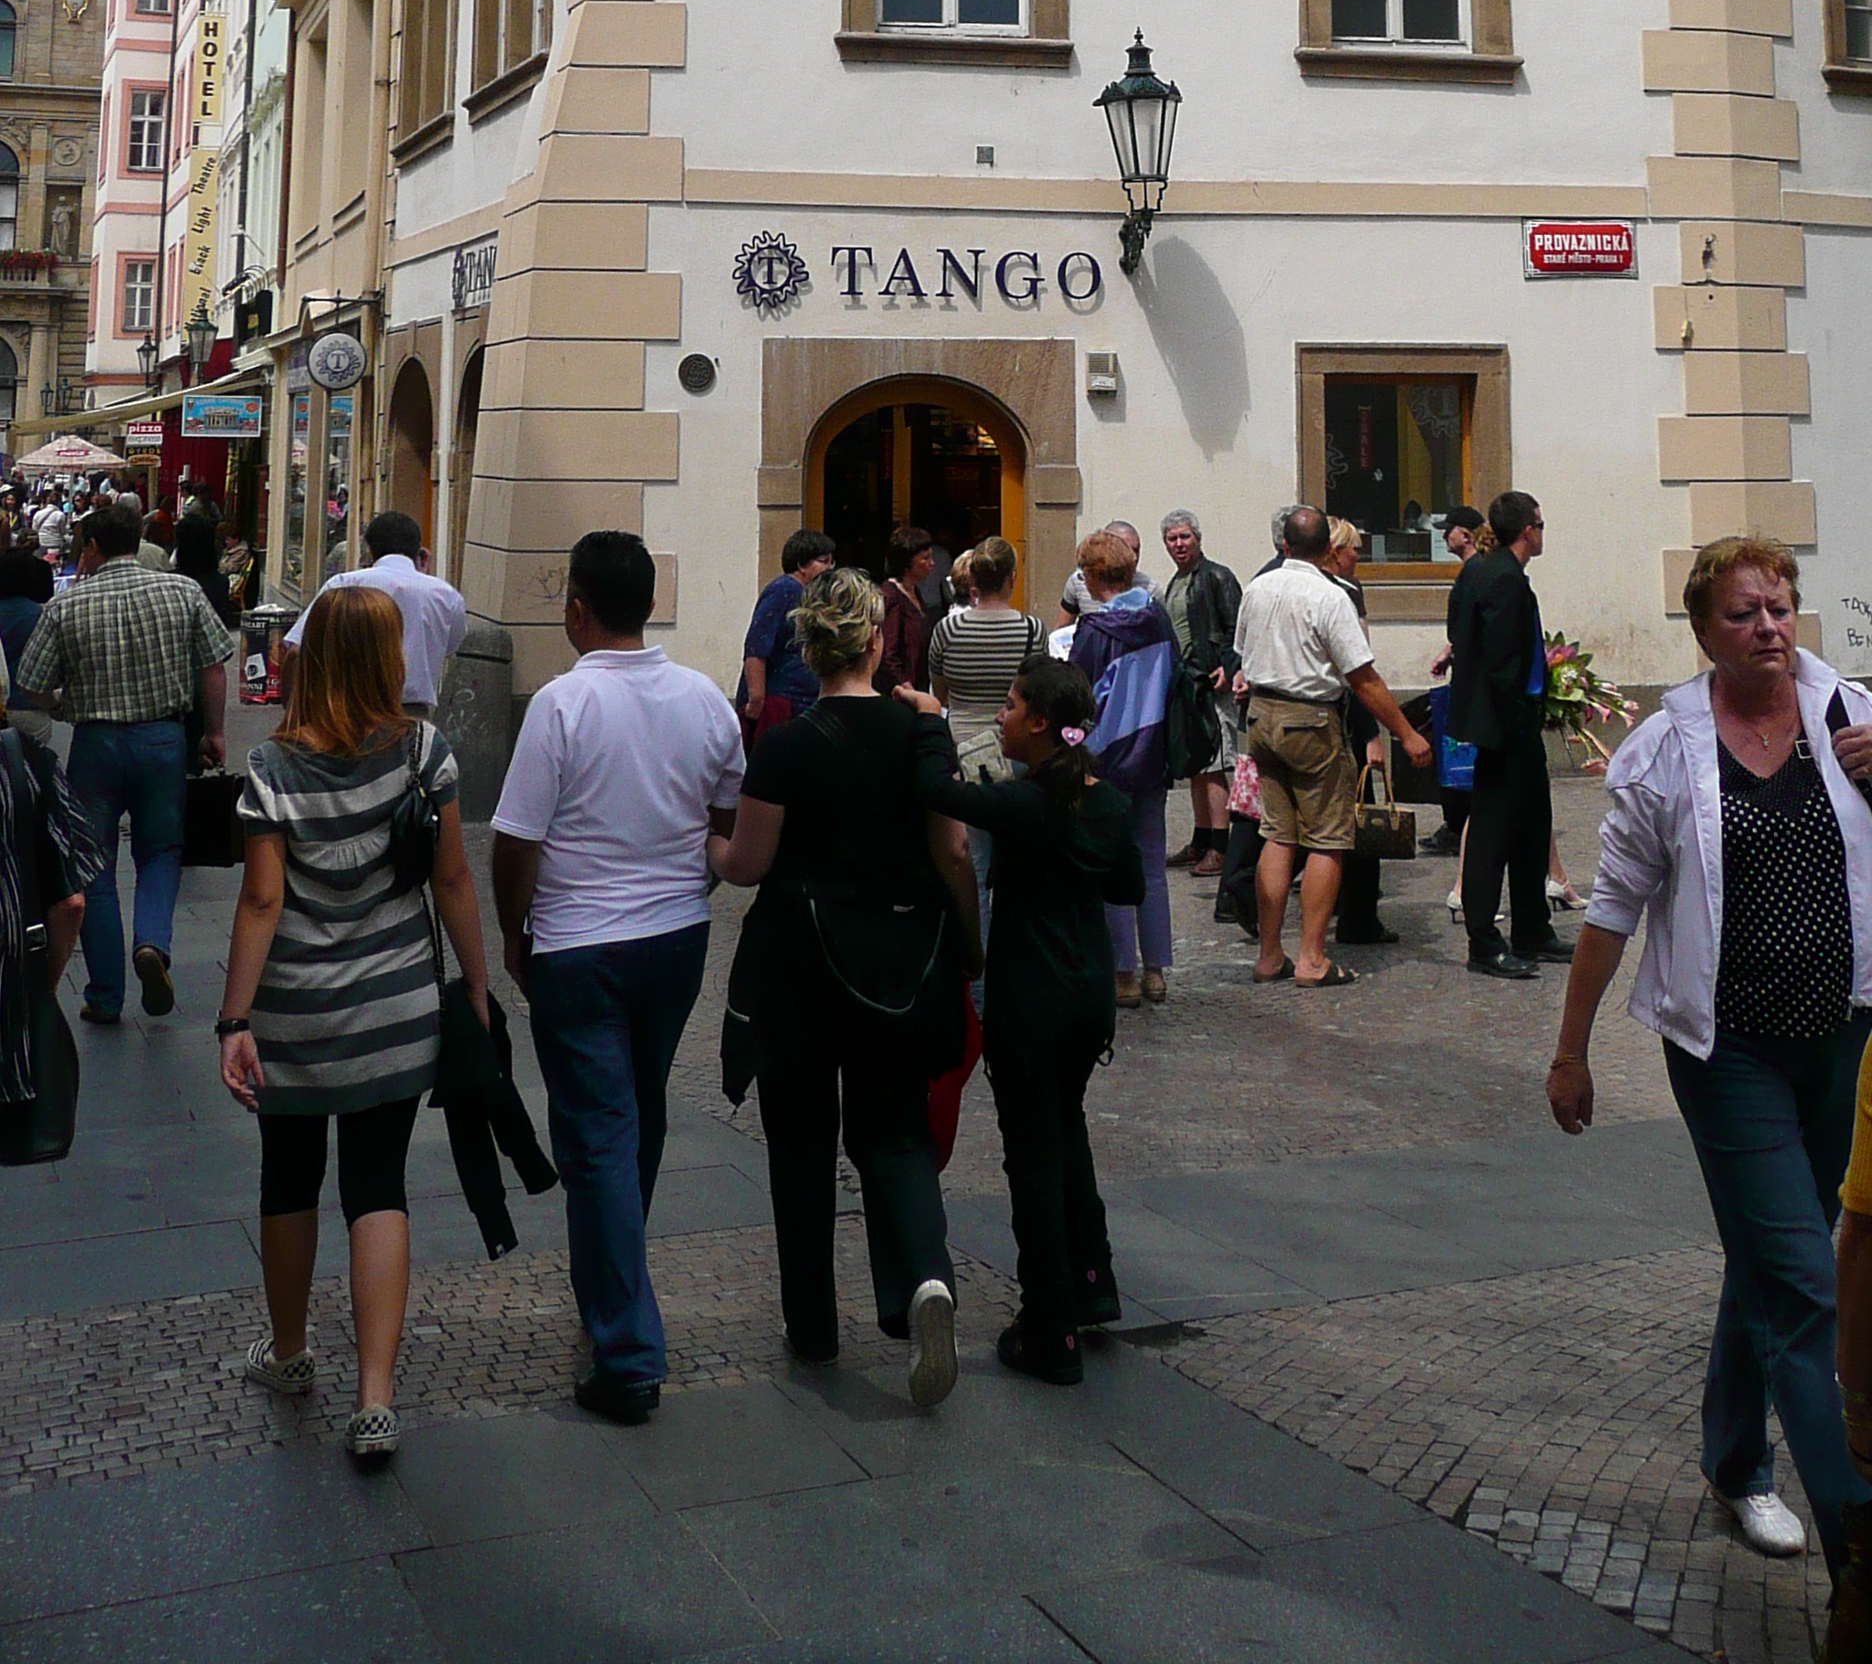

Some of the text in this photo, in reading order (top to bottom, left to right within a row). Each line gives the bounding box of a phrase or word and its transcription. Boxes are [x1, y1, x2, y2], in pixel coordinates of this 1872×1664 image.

[201, 21, 219, 117] HOTEL
[190, 156, 217, 195] Theatre
[191, 206, 213, 234] Light
[1534, 231, 1630, 251] PROVAZNICKÁ
[830, 245, 1102, 300] TANGO
[129, 422, 162, 434] pizza
